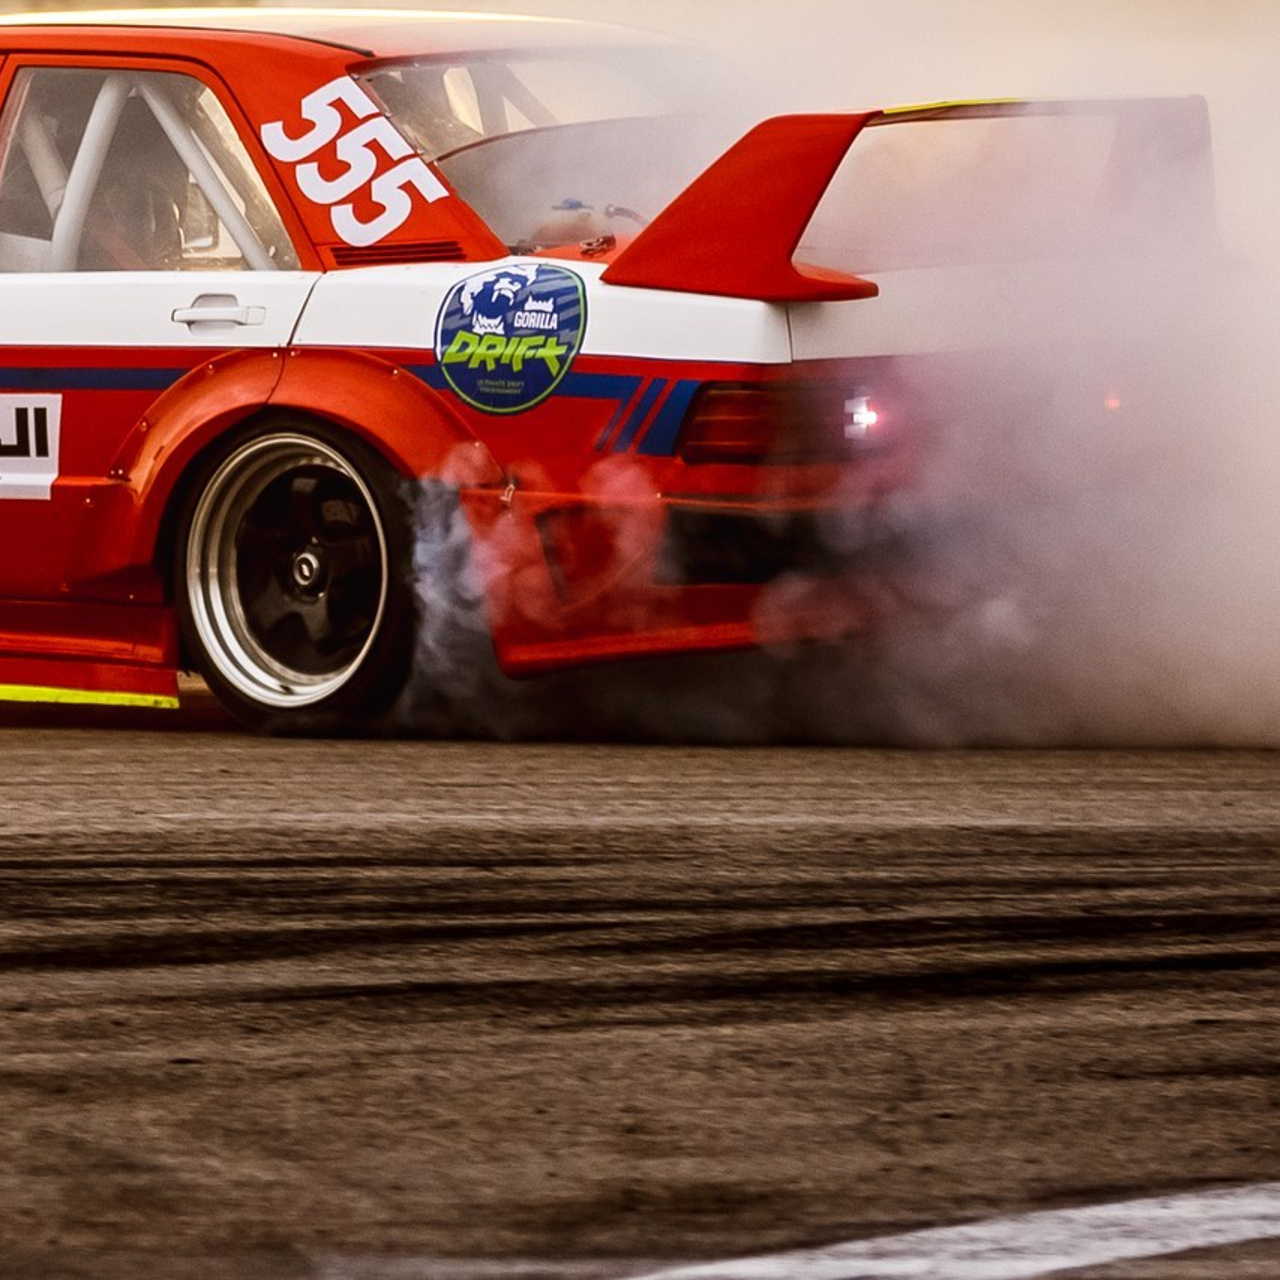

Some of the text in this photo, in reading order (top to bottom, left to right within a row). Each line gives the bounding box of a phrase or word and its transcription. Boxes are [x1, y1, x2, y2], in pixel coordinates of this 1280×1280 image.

[261, 75, 450, 247] 555
[513, 310, 559, 330] GORILLA
[442, 330, 568, 377] DRIFT
